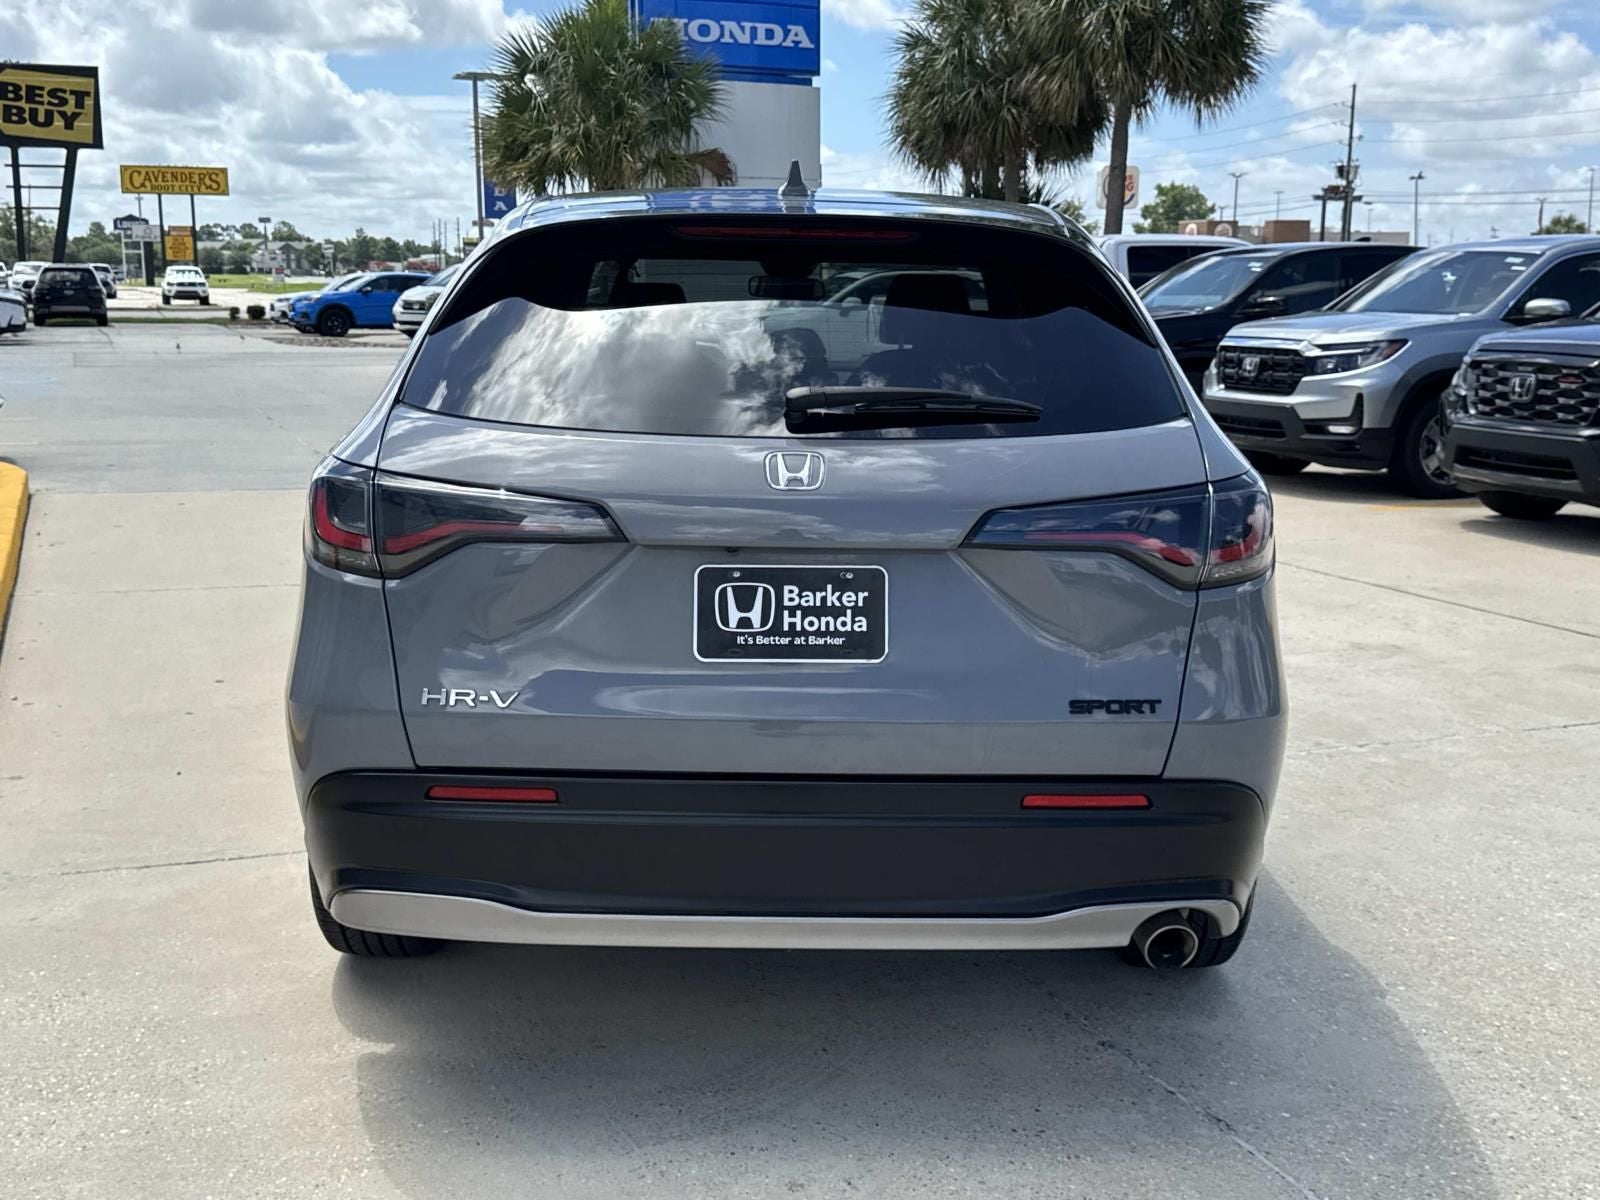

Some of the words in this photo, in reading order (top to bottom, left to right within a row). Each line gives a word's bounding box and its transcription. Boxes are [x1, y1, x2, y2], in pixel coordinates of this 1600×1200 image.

[0, 81, 91, 110] BEST
[2, 103, 84, 131] BUY
[128, 169, 221, 192] CAVENDER'S
[783, 584, 869, 607] Barker
[783, 609, 868, 632] Honda
[736, 634, 754, 645] It's
[755, 635, 792, 645] Better
[794, 635, 806, 645] at
[808, 635, 846, 645] Barker
[421, 688, 520, 708] HR-V
[1068, 699, 1162, 715] SPORT
